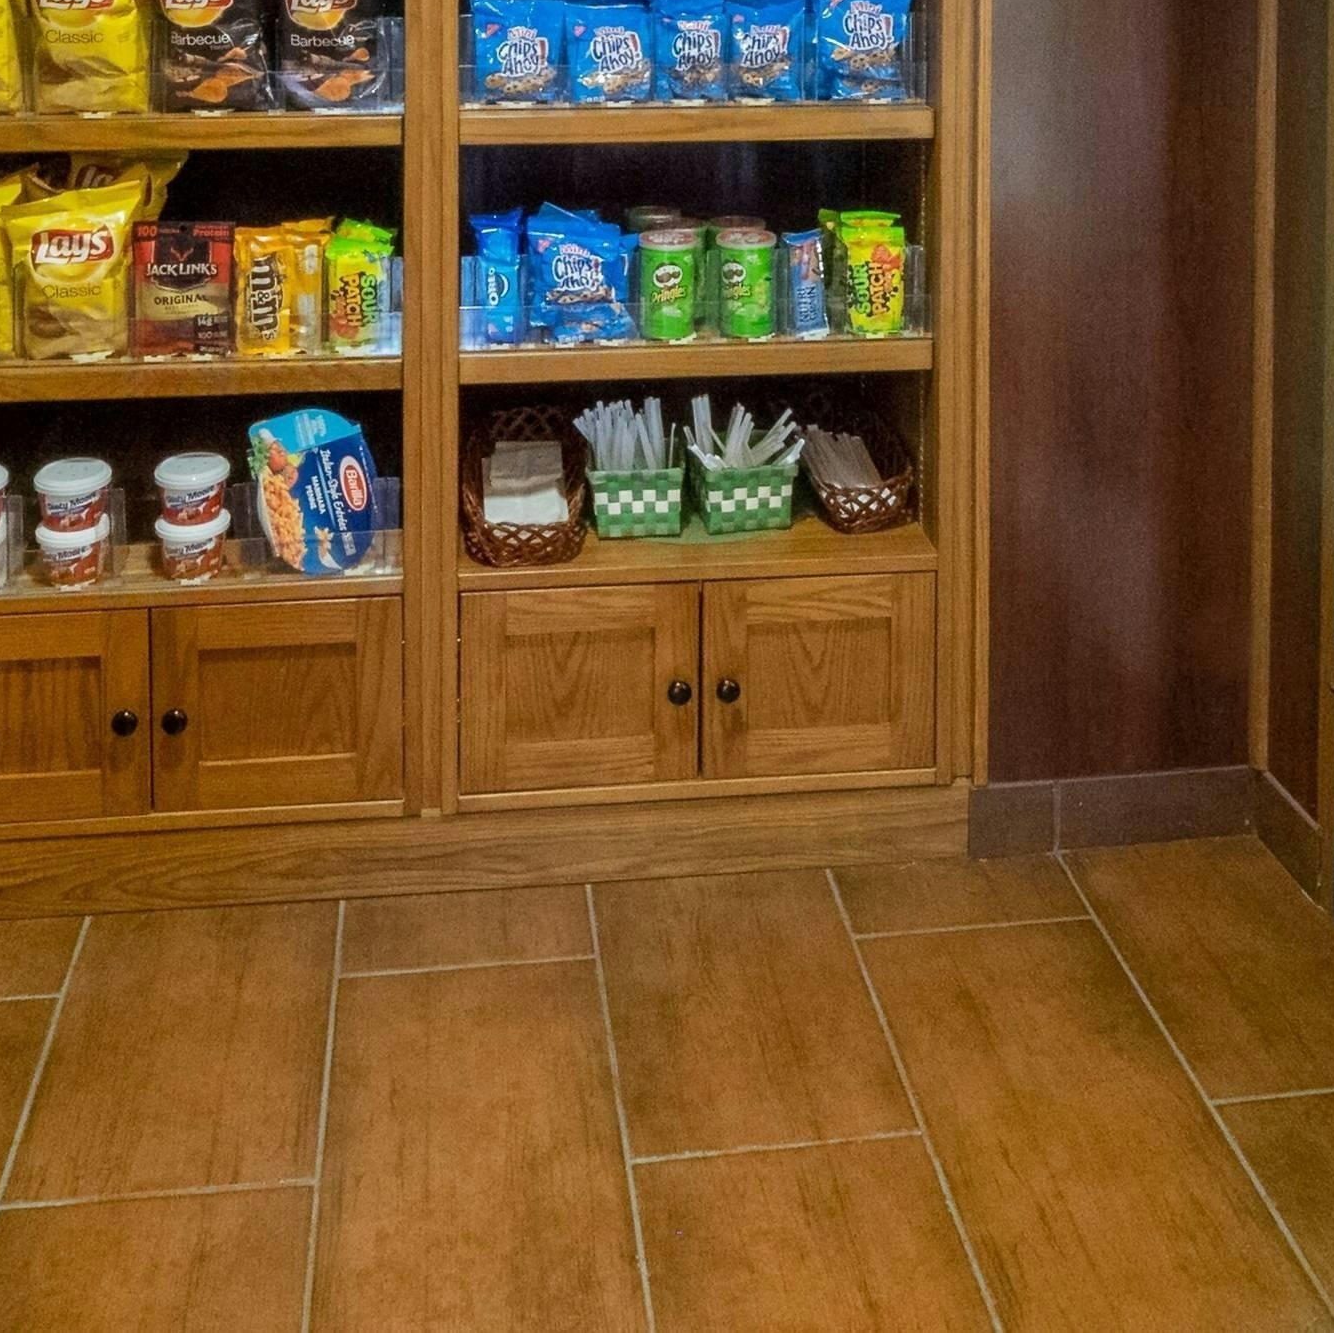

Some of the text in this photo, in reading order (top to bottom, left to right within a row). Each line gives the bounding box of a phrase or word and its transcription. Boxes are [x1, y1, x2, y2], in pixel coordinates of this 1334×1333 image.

[844, 15, 883, 34] Chips
[44, 30, 104, 44] Classic
[171, 31, 231, 46] Barbecue
[290, 33, 355, 48] Barbecue
[592, 35, 630, 59] Chips
[673, 33, 713, 56] Chips
[498, 41, 538, 61] Chips
[138, 226, 158, 237] 100
[35, 228, 108, 264] Lay's
[146, 263, 178, 276] JACK
[553, 256, 592, 281] Chips
[42, 284, 102, 299] Classic
[341, 272, 361, 327] PATCH
[360, 274, 377, 324] SOUR
[651, 286, 686, 303] Pringles
[855, 263, 869, 316] SOUR
[869, 262, 885, 316] PATCH
[345, 468, 365, 507] Barilla
